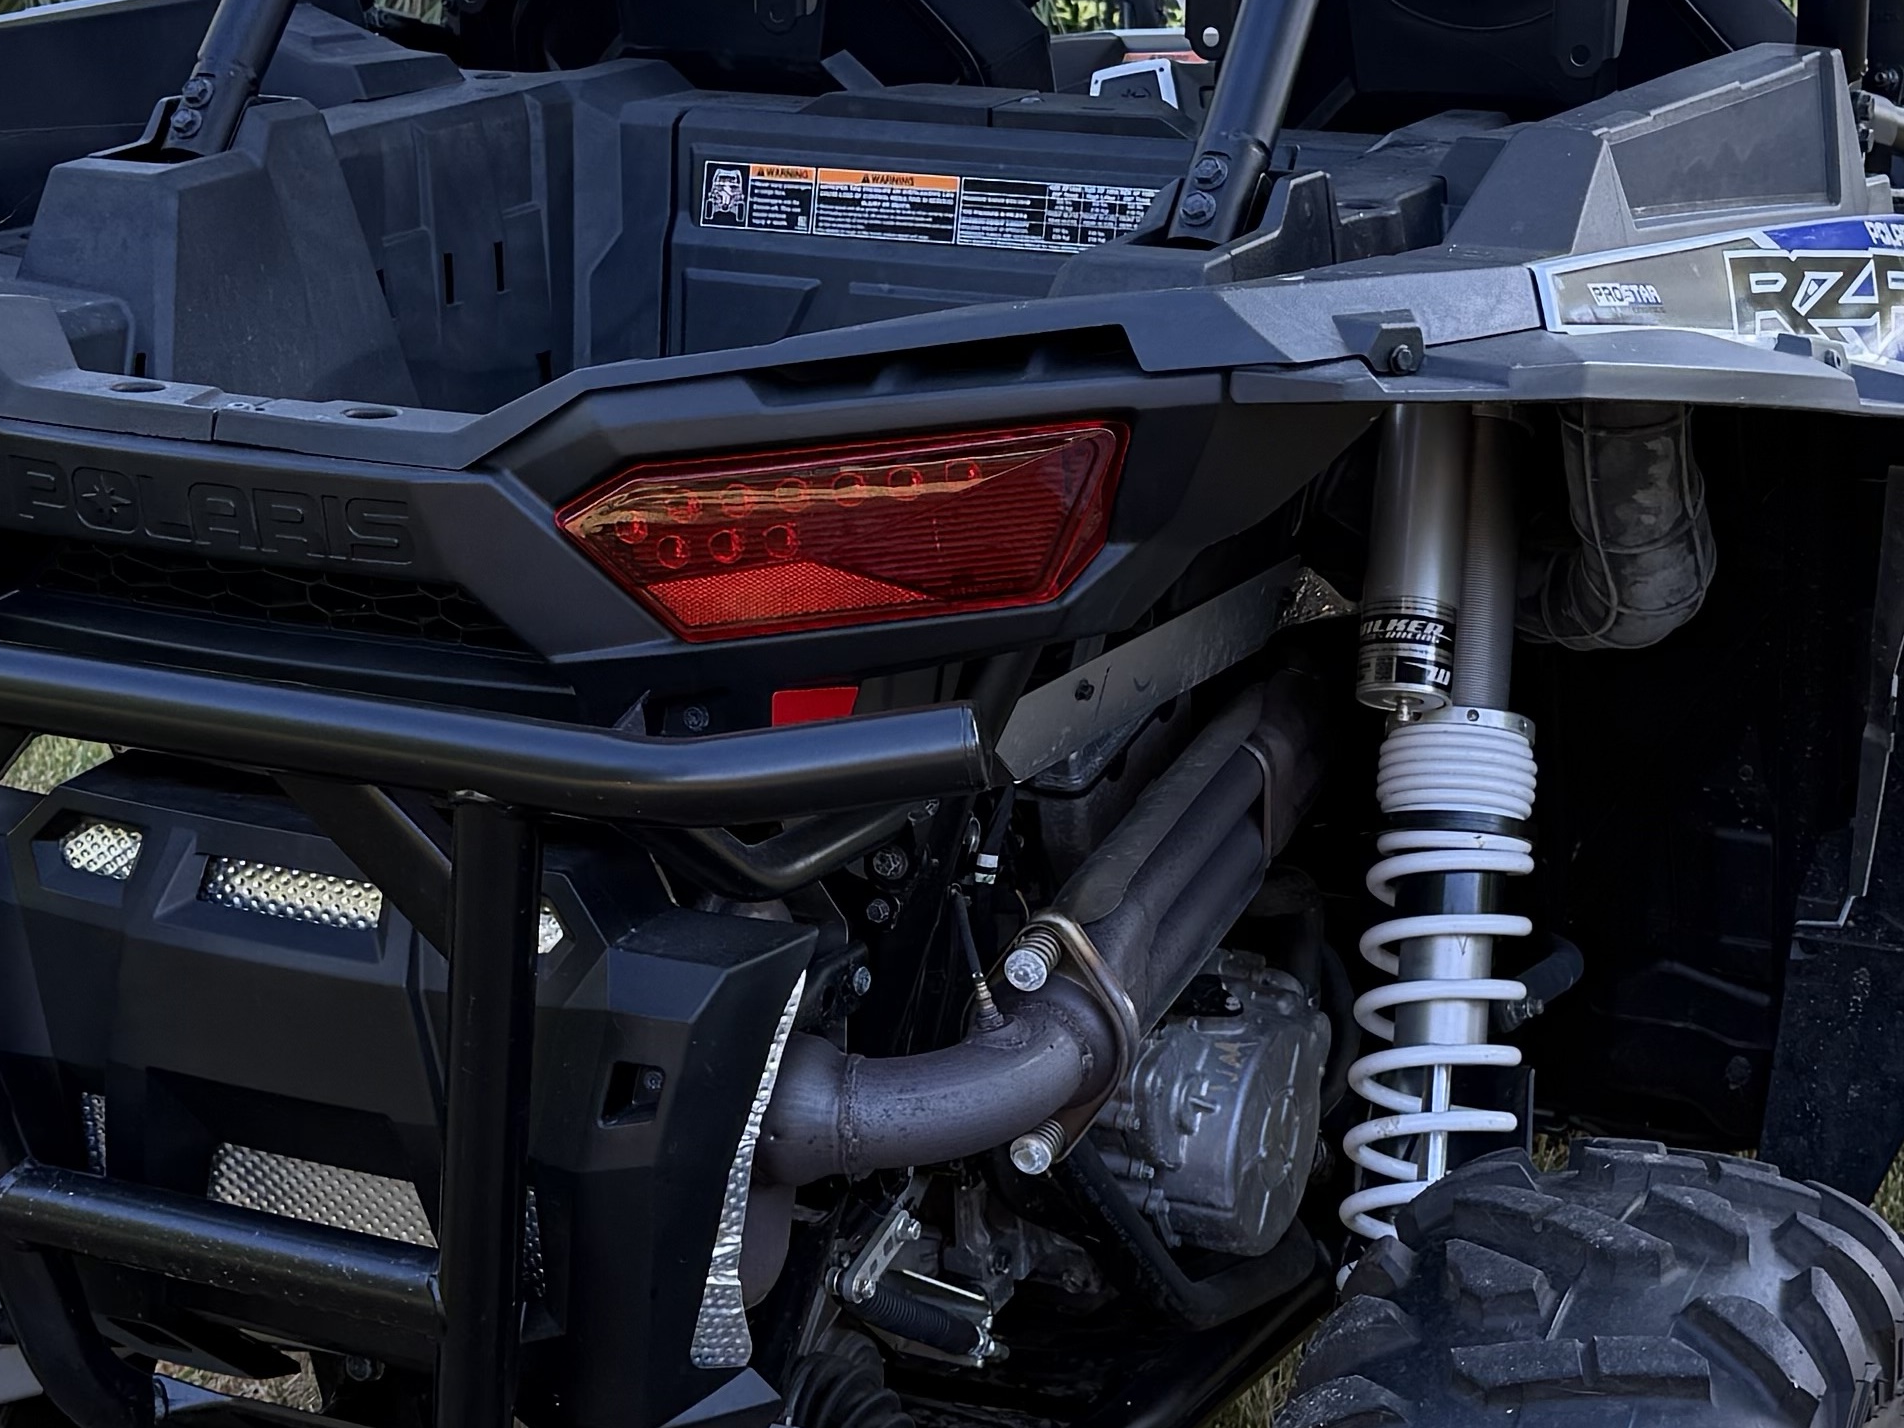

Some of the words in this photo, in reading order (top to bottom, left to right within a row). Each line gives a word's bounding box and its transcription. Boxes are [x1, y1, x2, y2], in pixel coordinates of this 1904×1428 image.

[767, 168, 809, 180] WARNING
[871, 174, 914, 187] WARNING
[1589, 284, 1663, 306] PROSTAR
[8, 453, 415, 567] POLARIS
